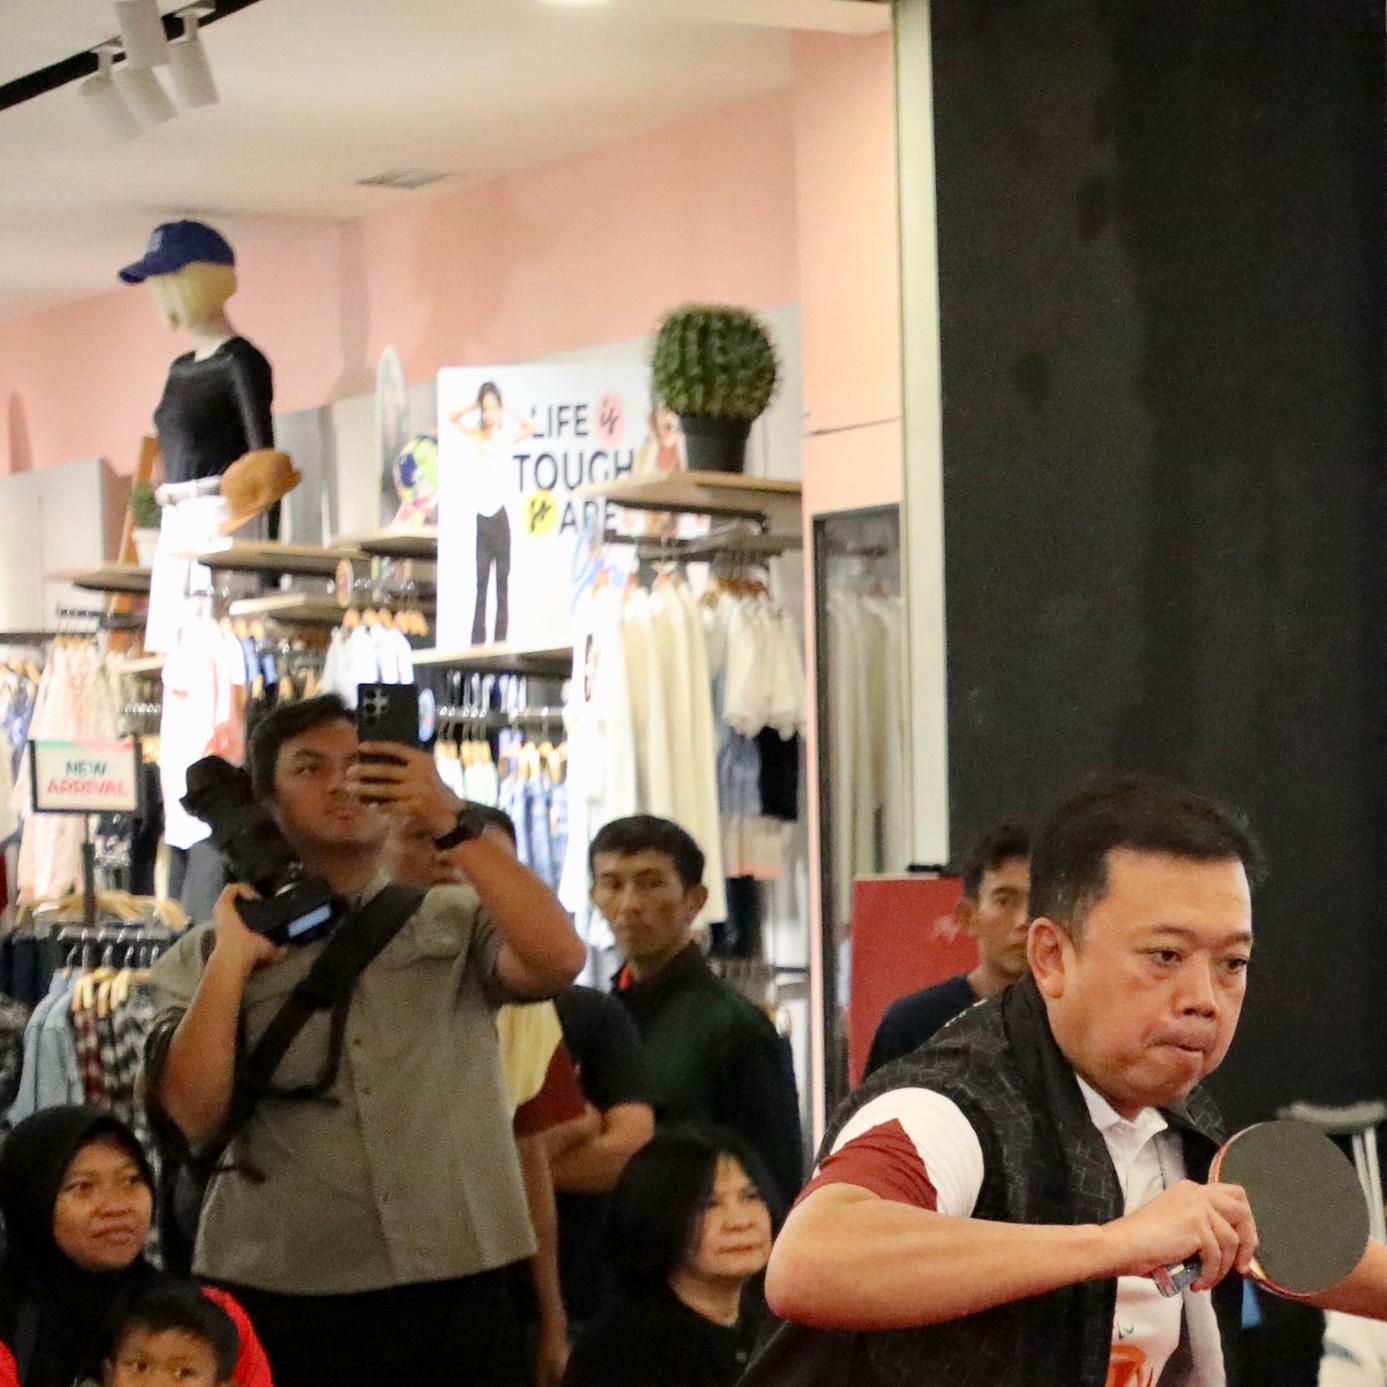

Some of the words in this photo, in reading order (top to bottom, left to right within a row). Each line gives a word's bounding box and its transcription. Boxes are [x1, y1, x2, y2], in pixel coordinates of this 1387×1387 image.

[531, 403, 588, 439] LIFE
[513, 449, 634, 492] TOUGH
[65, 761, 107, 775] NEW
